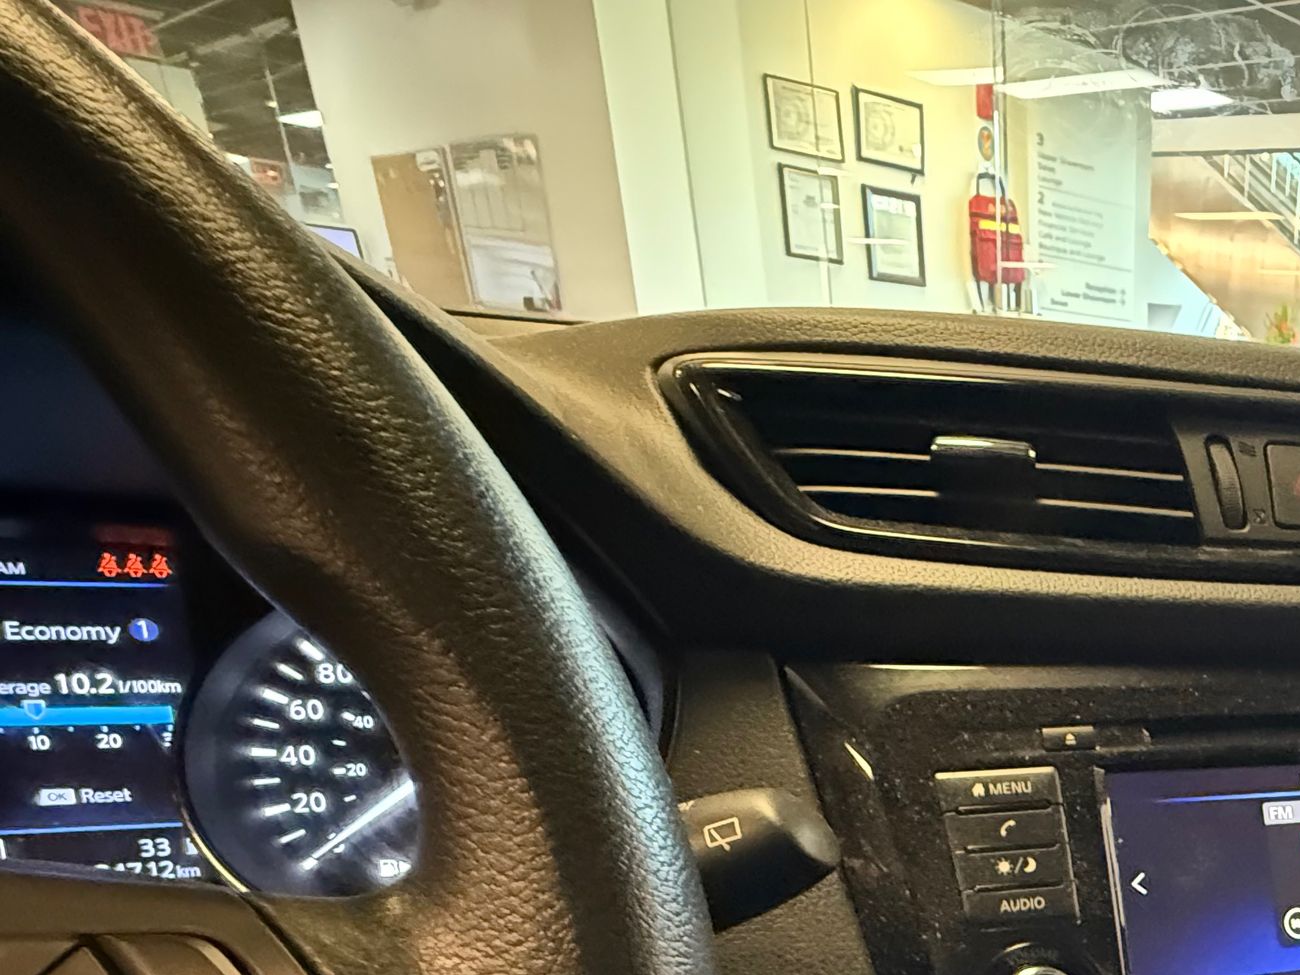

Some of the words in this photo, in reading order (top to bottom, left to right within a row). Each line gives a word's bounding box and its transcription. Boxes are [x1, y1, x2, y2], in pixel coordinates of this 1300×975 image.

[3, 620, 122, 645] Economy
[316, 663, 353, 685] 80
[54, 672, 116, 695] 10.2
[289, 699, 324, 721] 60
[352, 714, 375, 729] 40
[27, 734, 51, 751] 10
[95, 733, 123, 750] 20
[279, 744, 316, 766] 40
[346, 763, 367, 777] 20
[79, 788, 133, 804] Reset
[989, 781, 1032, 796] MENU
[291, 791, 327, 814] 20
[1268, 805, 1294, 820] FM
[138, 837, 172, 858] 33
[176, 865, 201, 878] km
[1000, 896, 1046, 913] AUDIO
